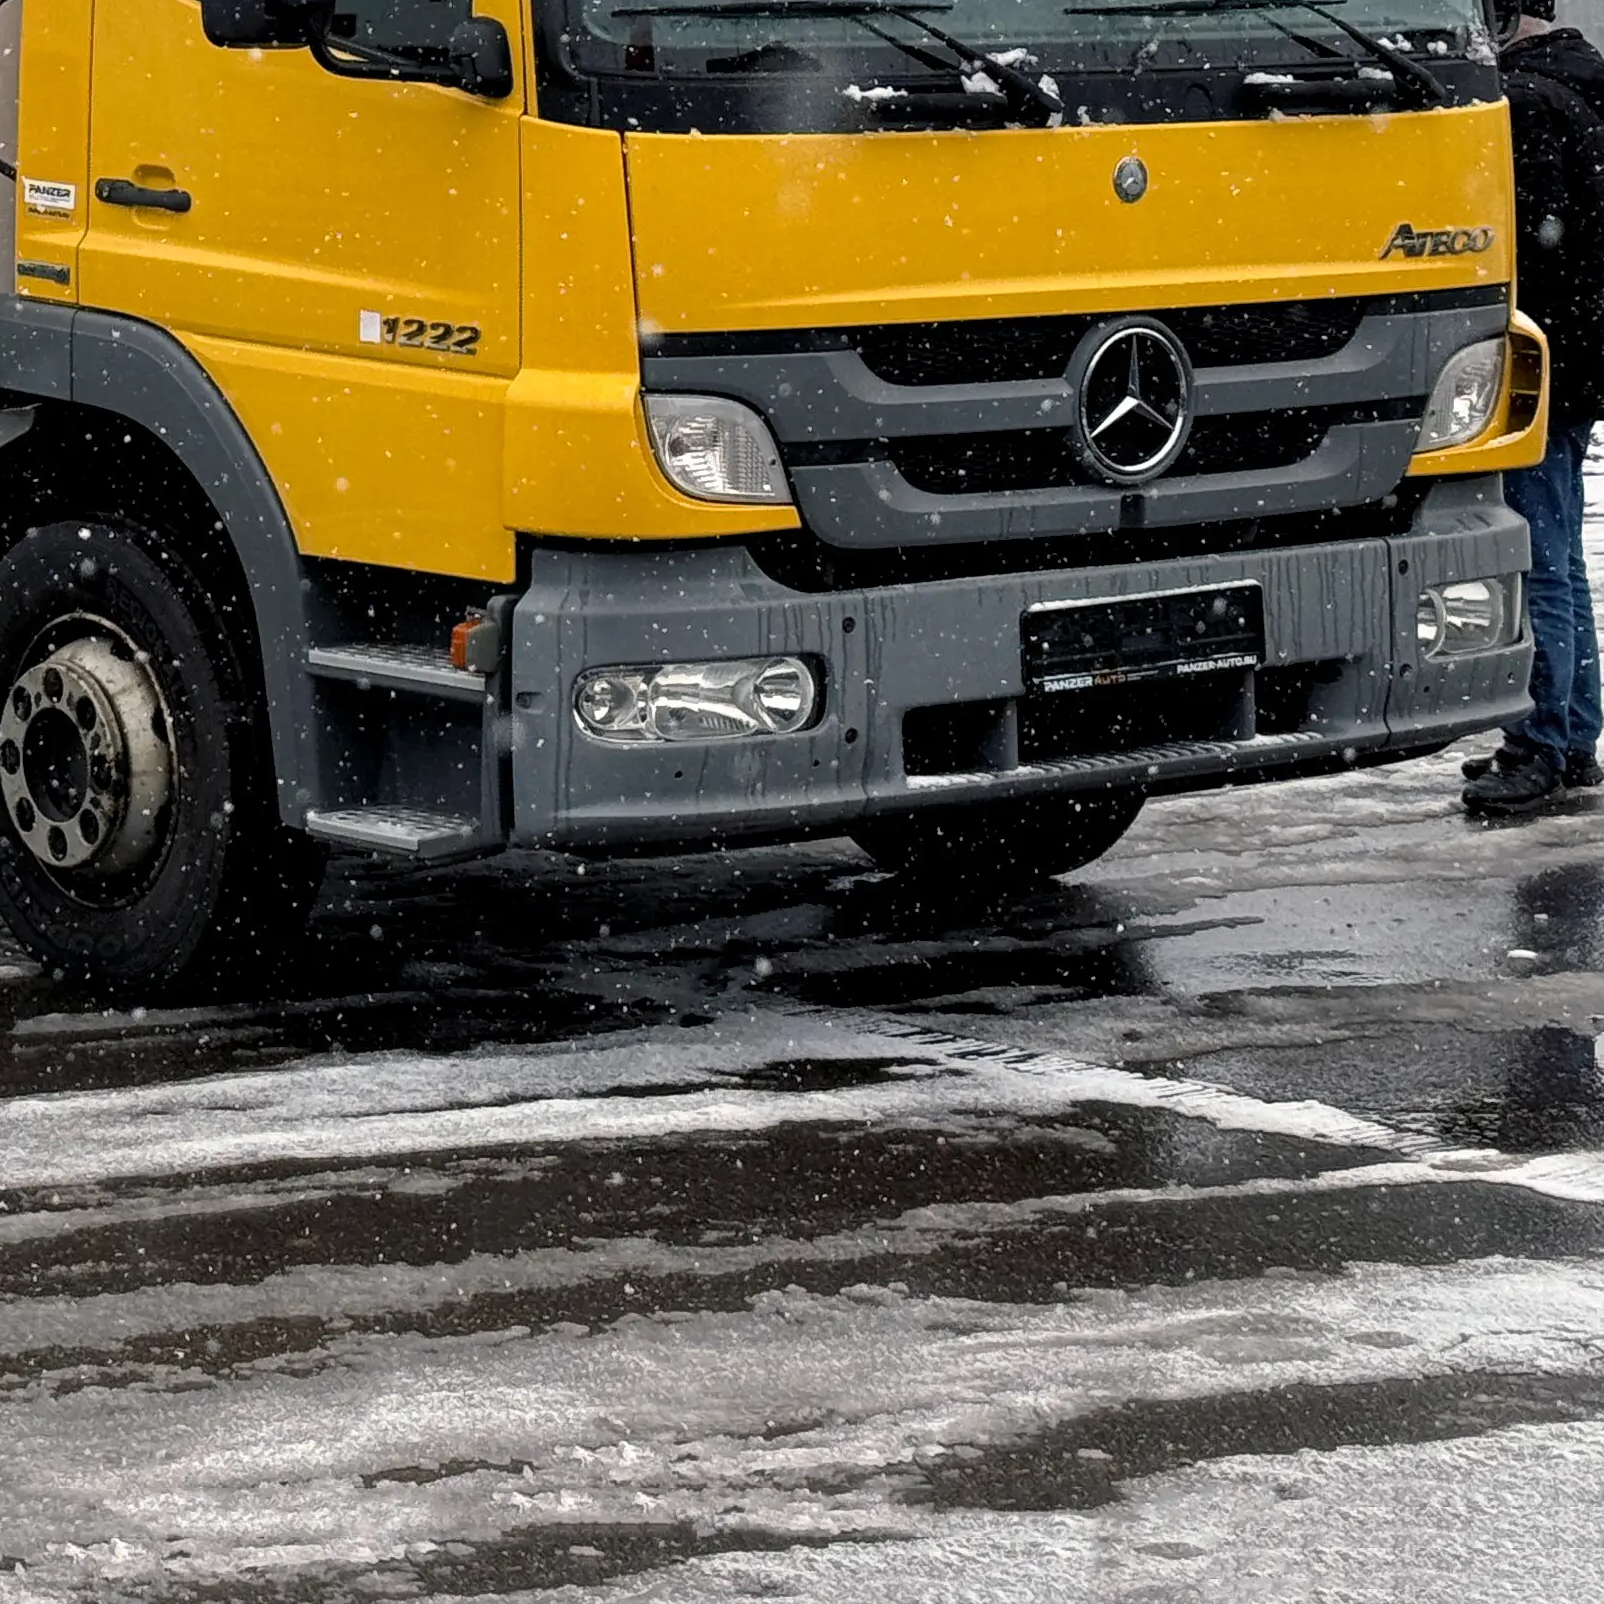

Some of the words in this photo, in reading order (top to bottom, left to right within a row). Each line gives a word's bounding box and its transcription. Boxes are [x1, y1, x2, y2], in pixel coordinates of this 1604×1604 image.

[1378, 223, 1496, 261] ATECO
[382, 316, 481, 356] 1222
[1043, 676, 1094, 693] PANZER
[1095, 674, 1127, 686] AUTO
